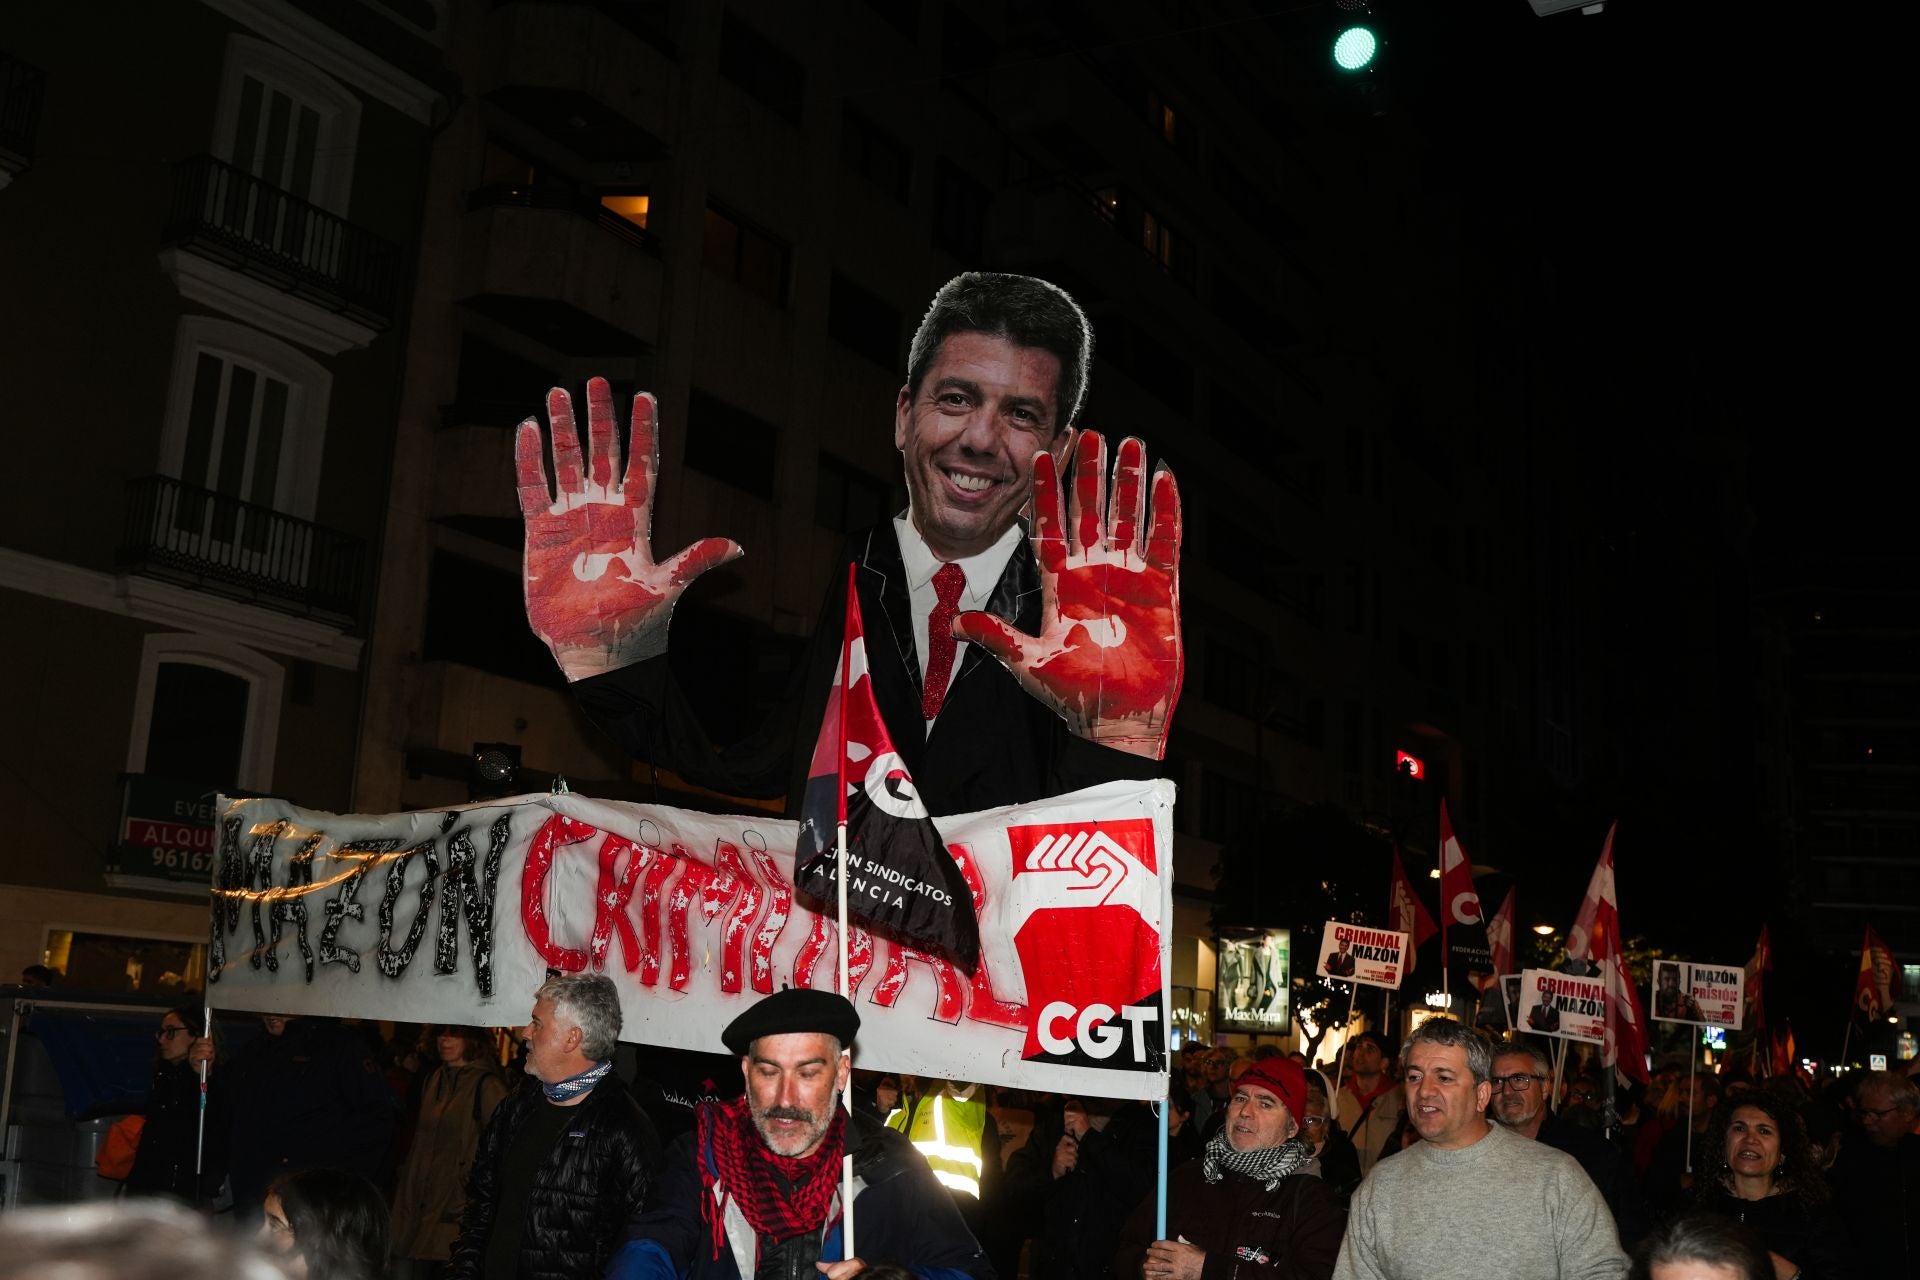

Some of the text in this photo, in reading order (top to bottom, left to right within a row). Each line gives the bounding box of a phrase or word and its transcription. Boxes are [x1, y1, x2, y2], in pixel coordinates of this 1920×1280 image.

[152, 846, 213, 872] 96167
[801, 863, 904, 909] ALNCIA
[864, 861, 952, 907] SINDICATOS
[1335, 926, 1400, 949] CRIMINAL
[1695, 969, 1738, 985] MAZÓN
[1692, 986, 1738, 1003] PRISIÓN
[1037, 1001, 1158, 1063] CGT
